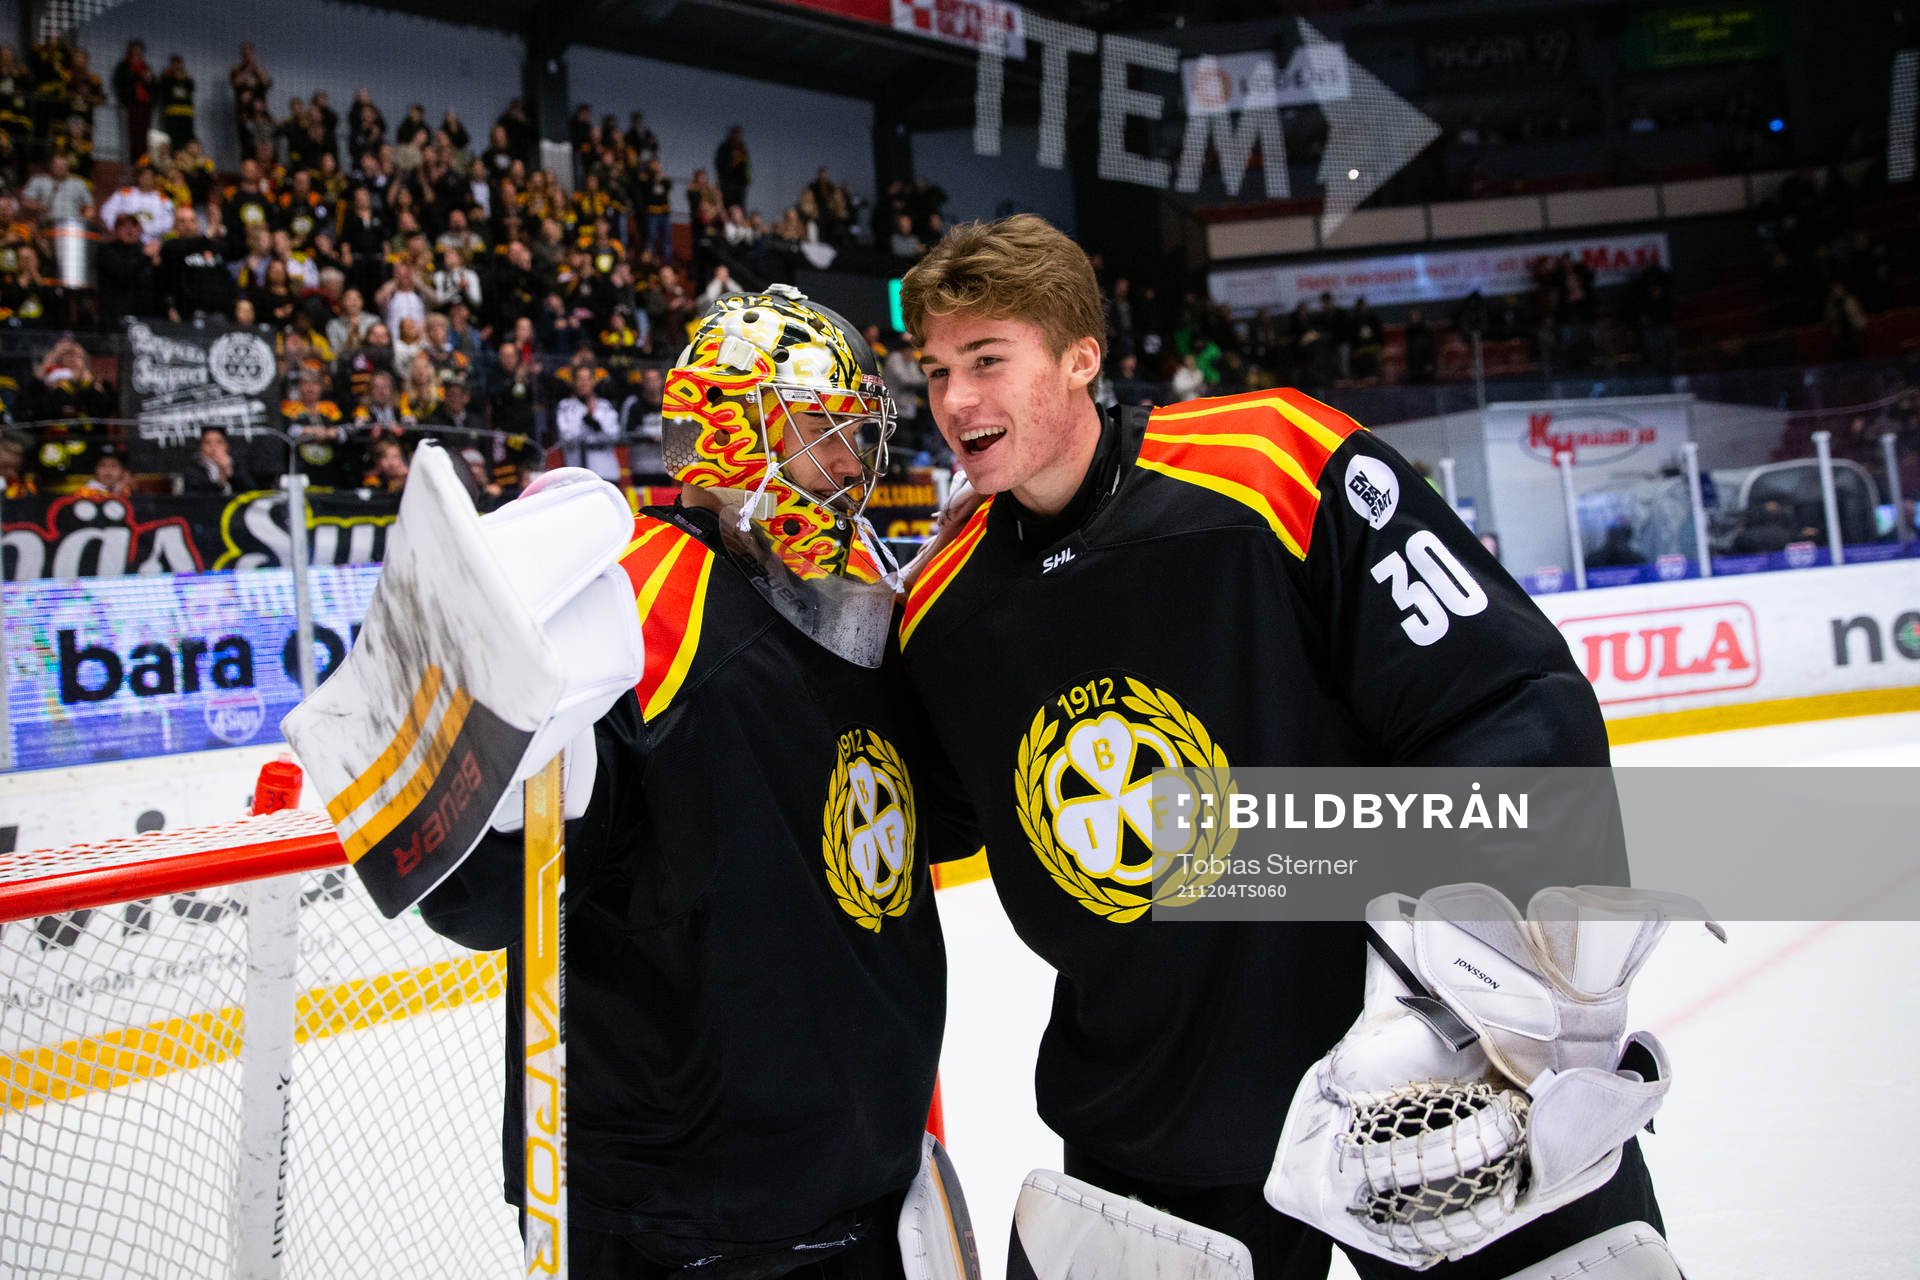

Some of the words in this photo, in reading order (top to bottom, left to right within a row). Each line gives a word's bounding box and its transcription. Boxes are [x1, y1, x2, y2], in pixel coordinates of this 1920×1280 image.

[714, 295, 774, 310] 1912
[1349, 470, 1370, 496] EN
[1371, 488, 1392, 523] START
[1043, 547, 1076, 574] SHL
[1370, 530, 1489, 647] 30
[57, 629, 255, 704] bara
[1581, 621, 1750, 685] JULA
[1057, 677, 1116, 720] 1912
[837, 728, 865, 762] 1912
[1092, 737, 1115, 772] B
[264, 790, 287, 809] 35
[857, 777, 869, 805] B
[1146, 795, 1170, 831] F
[884, 825, 897, 854] F
[1084, 817, 1099, 850] I
[1452, 957, 1501, 990] JONSSON
